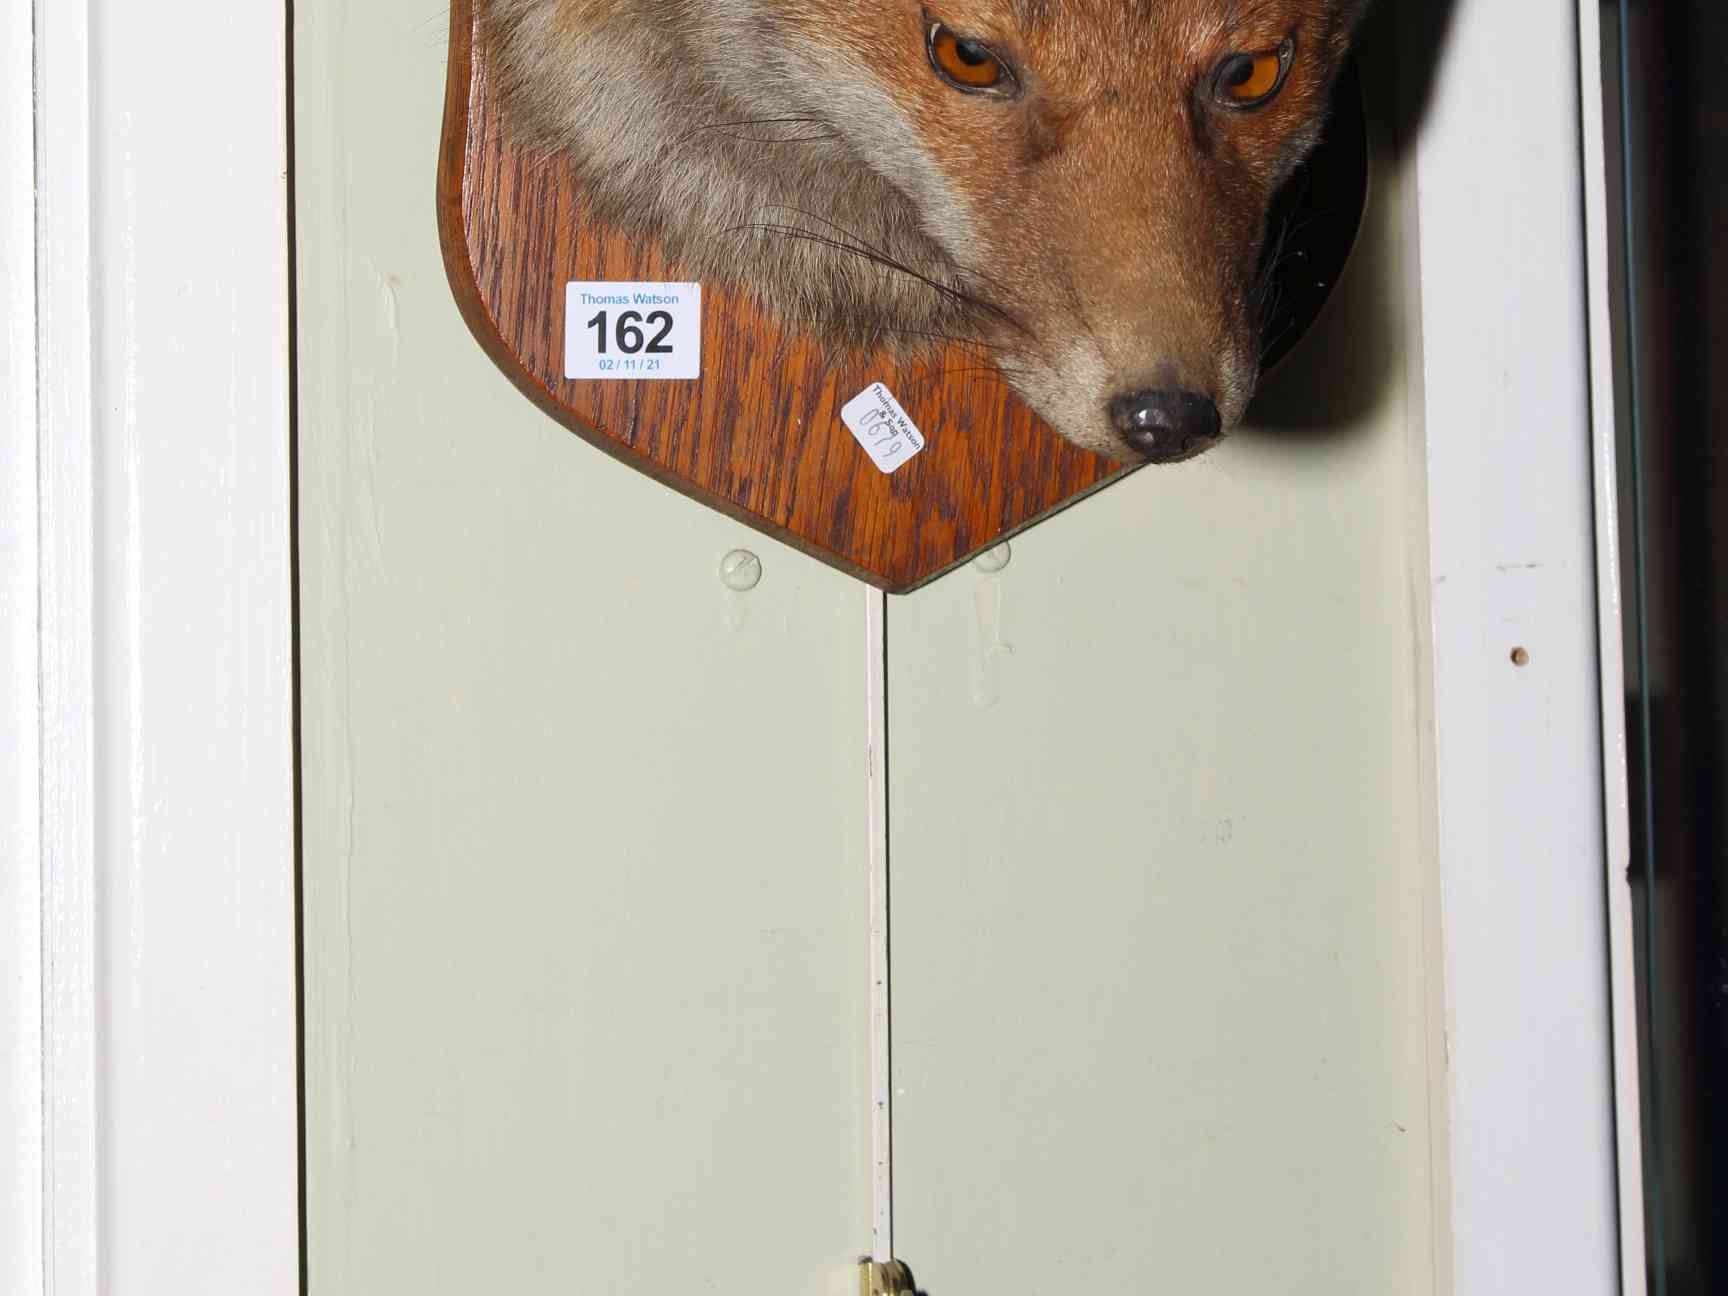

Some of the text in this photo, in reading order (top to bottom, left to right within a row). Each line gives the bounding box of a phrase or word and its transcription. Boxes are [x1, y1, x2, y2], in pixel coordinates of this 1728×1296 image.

[580, 293, 679, 304] Thomas Watson
[587, 310, 674, 354] 162
[872, 385, 921, 450] Thomas Watson
